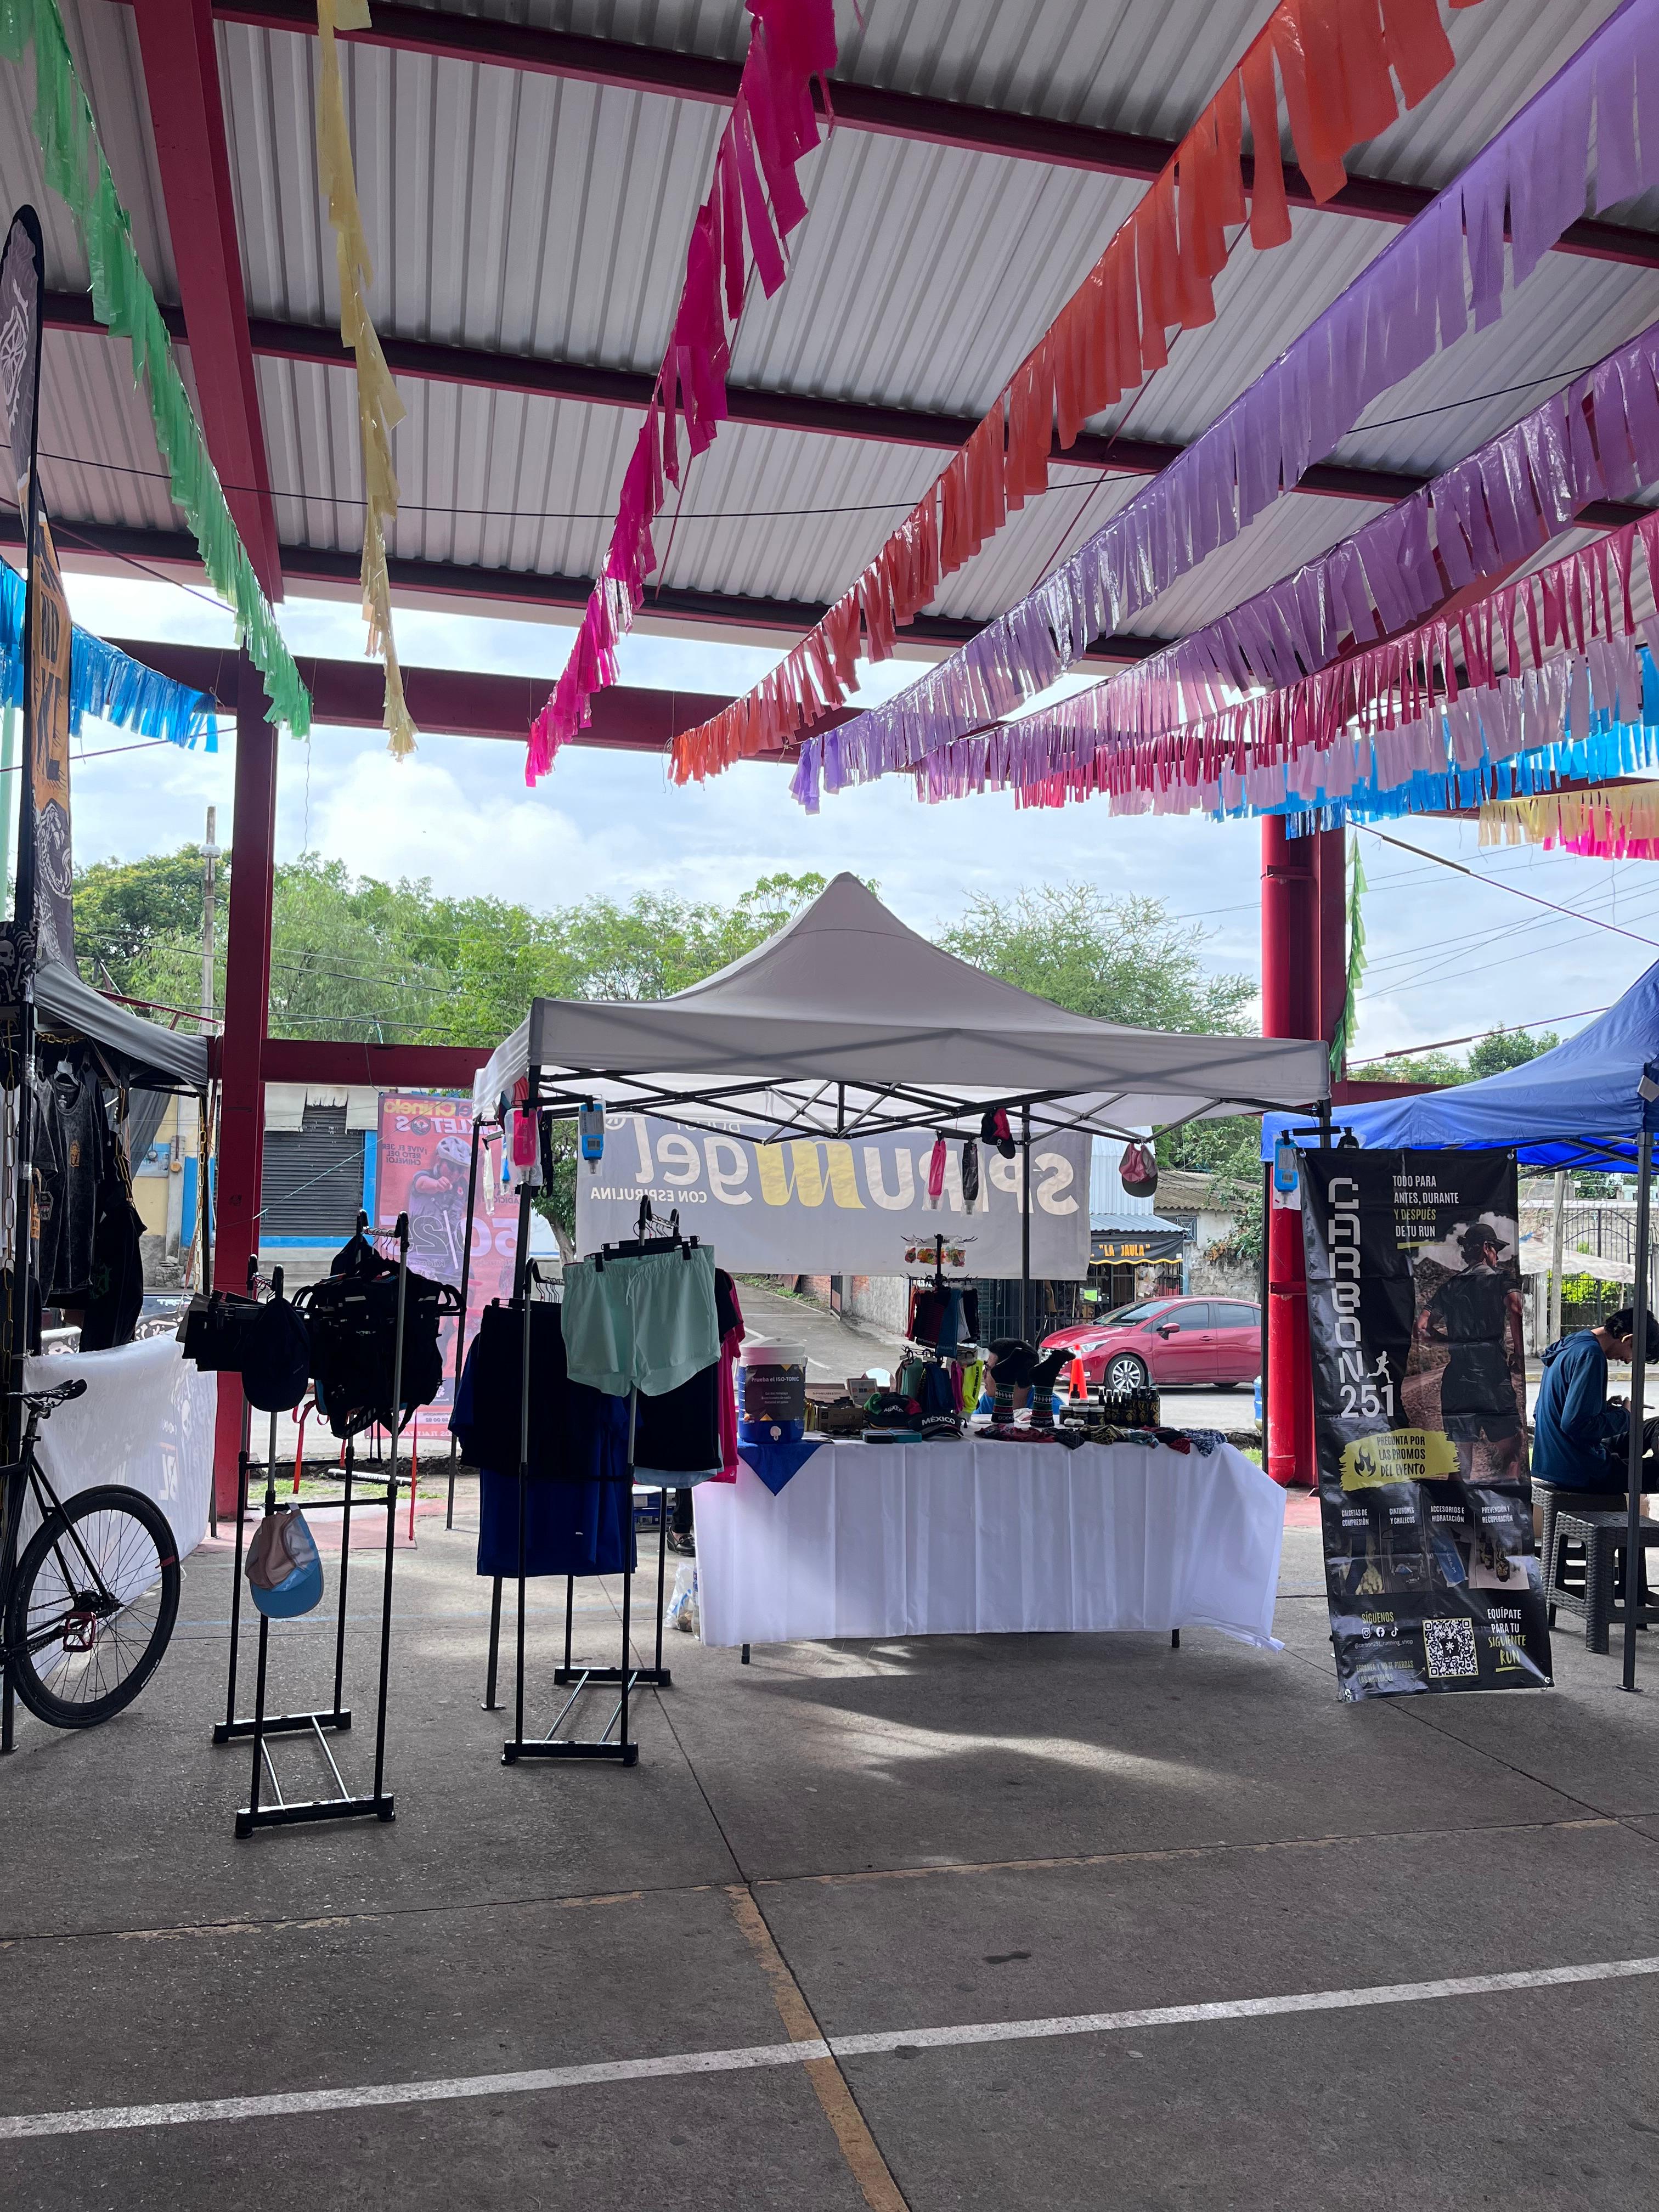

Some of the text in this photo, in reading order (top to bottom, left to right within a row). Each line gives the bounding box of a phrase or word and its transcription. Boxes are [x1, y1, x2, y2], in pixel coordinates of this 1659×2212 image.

[1392, 1175, 1437, 1187] TODO PARA
[1393, 1192, 1459, 1205] ANTES, DURANTE
[1393, 1206, 1437, 1221] Y DESPUÉS
[1395, 1225, 1436, 1237] DE TU RUN
[1328, 1177, 1364, 1383] CARBON
[1340, 1384, 1394, 1419] 251
[921, 1415, 956, 1426] MÉXICO
[1376, 1435, 1425, 1446] PREGUNTA POR
[1379, 1448, 1426, 1460] LAS PROMOS
[1380, 1462, 1425, 1477] DEL EVENTO
[1389, 1506, 1414, 1515] CINTURONES
[1430, 1505, 1462, 1514] ACCESORIOS
[1481, 1505, 1506, 1514] PREVENCIÓN
[1342, 1517, 1369, 1527] COMPRESIÓN
[1393, 1516, 1415, 1525] CHALECOS
[1431, 1514, 1464, 1523] HIDRATACIÓN
[1482, 1514, 1514, 1523] RECUPERACIÓN
[1361, 1611, 1395, 1624] SÍGUENOS
[1487, 1606, 1522, 1620] EQUÍPATE
[1491, 1623, 1520, 1634] PARA TU
[1488, 1634, 1527, 1648] SIGUIENTE
[1499, 1649, 1521, 1666] RUN
[1394, 1660, 1414, 1669] PIERDAS
